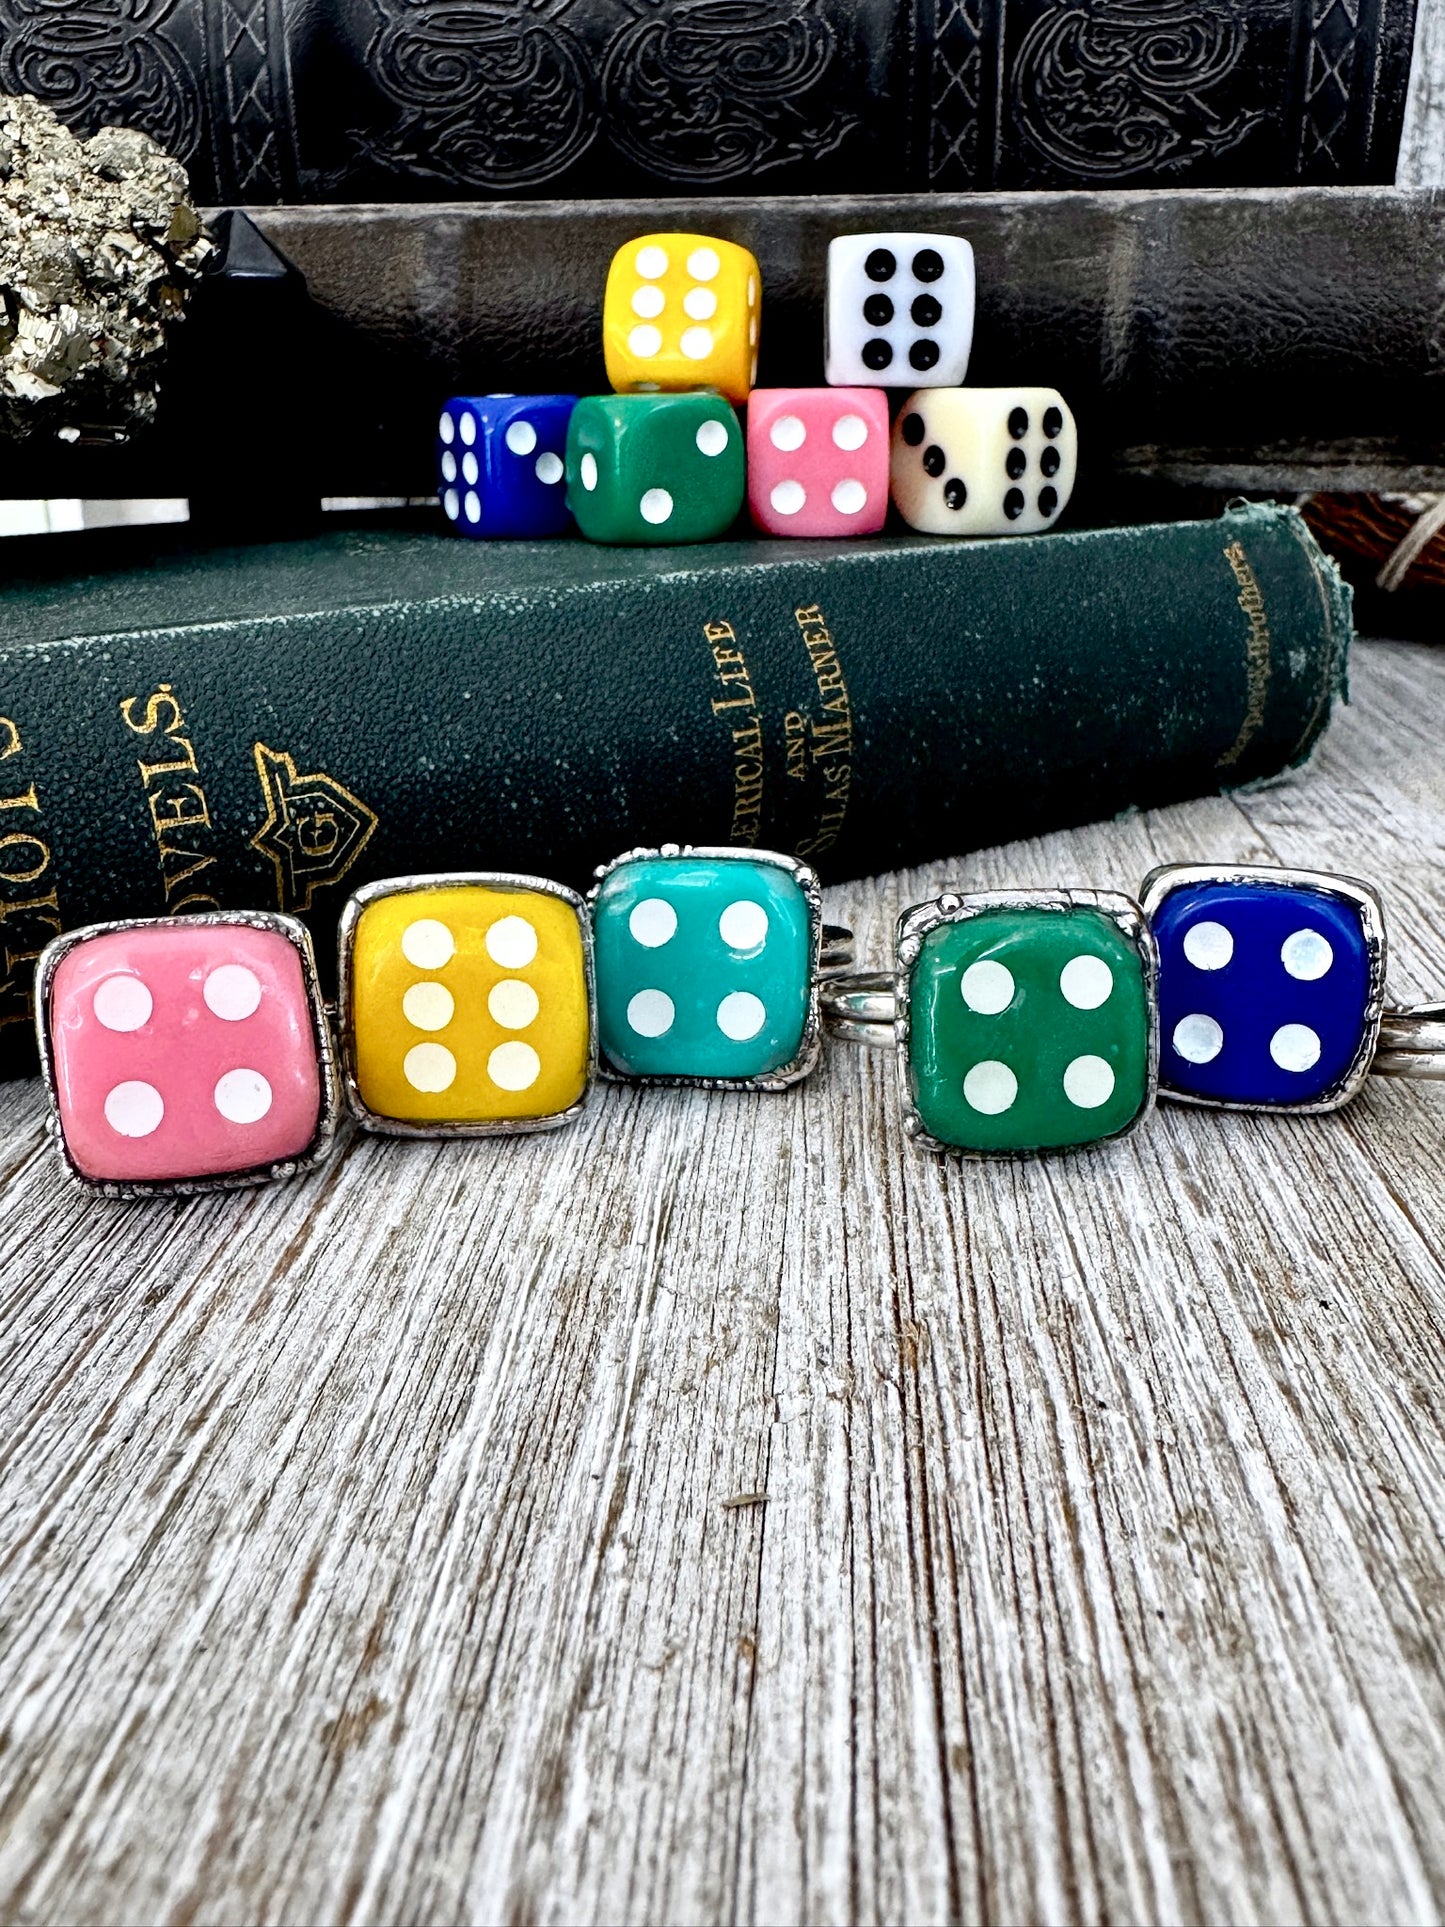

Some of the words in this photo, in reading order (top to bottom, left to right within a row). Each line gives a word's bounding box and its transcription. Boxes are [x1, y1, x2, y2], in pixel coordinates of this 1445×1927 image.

[703, 620, 757, 716] LIFE
[794, 603, 853, 764] MARNER
[730, 712, 764, 847] ERICAL
[784, 711, 807, 781] AND
[795, 763, 851, 857] SILAS
